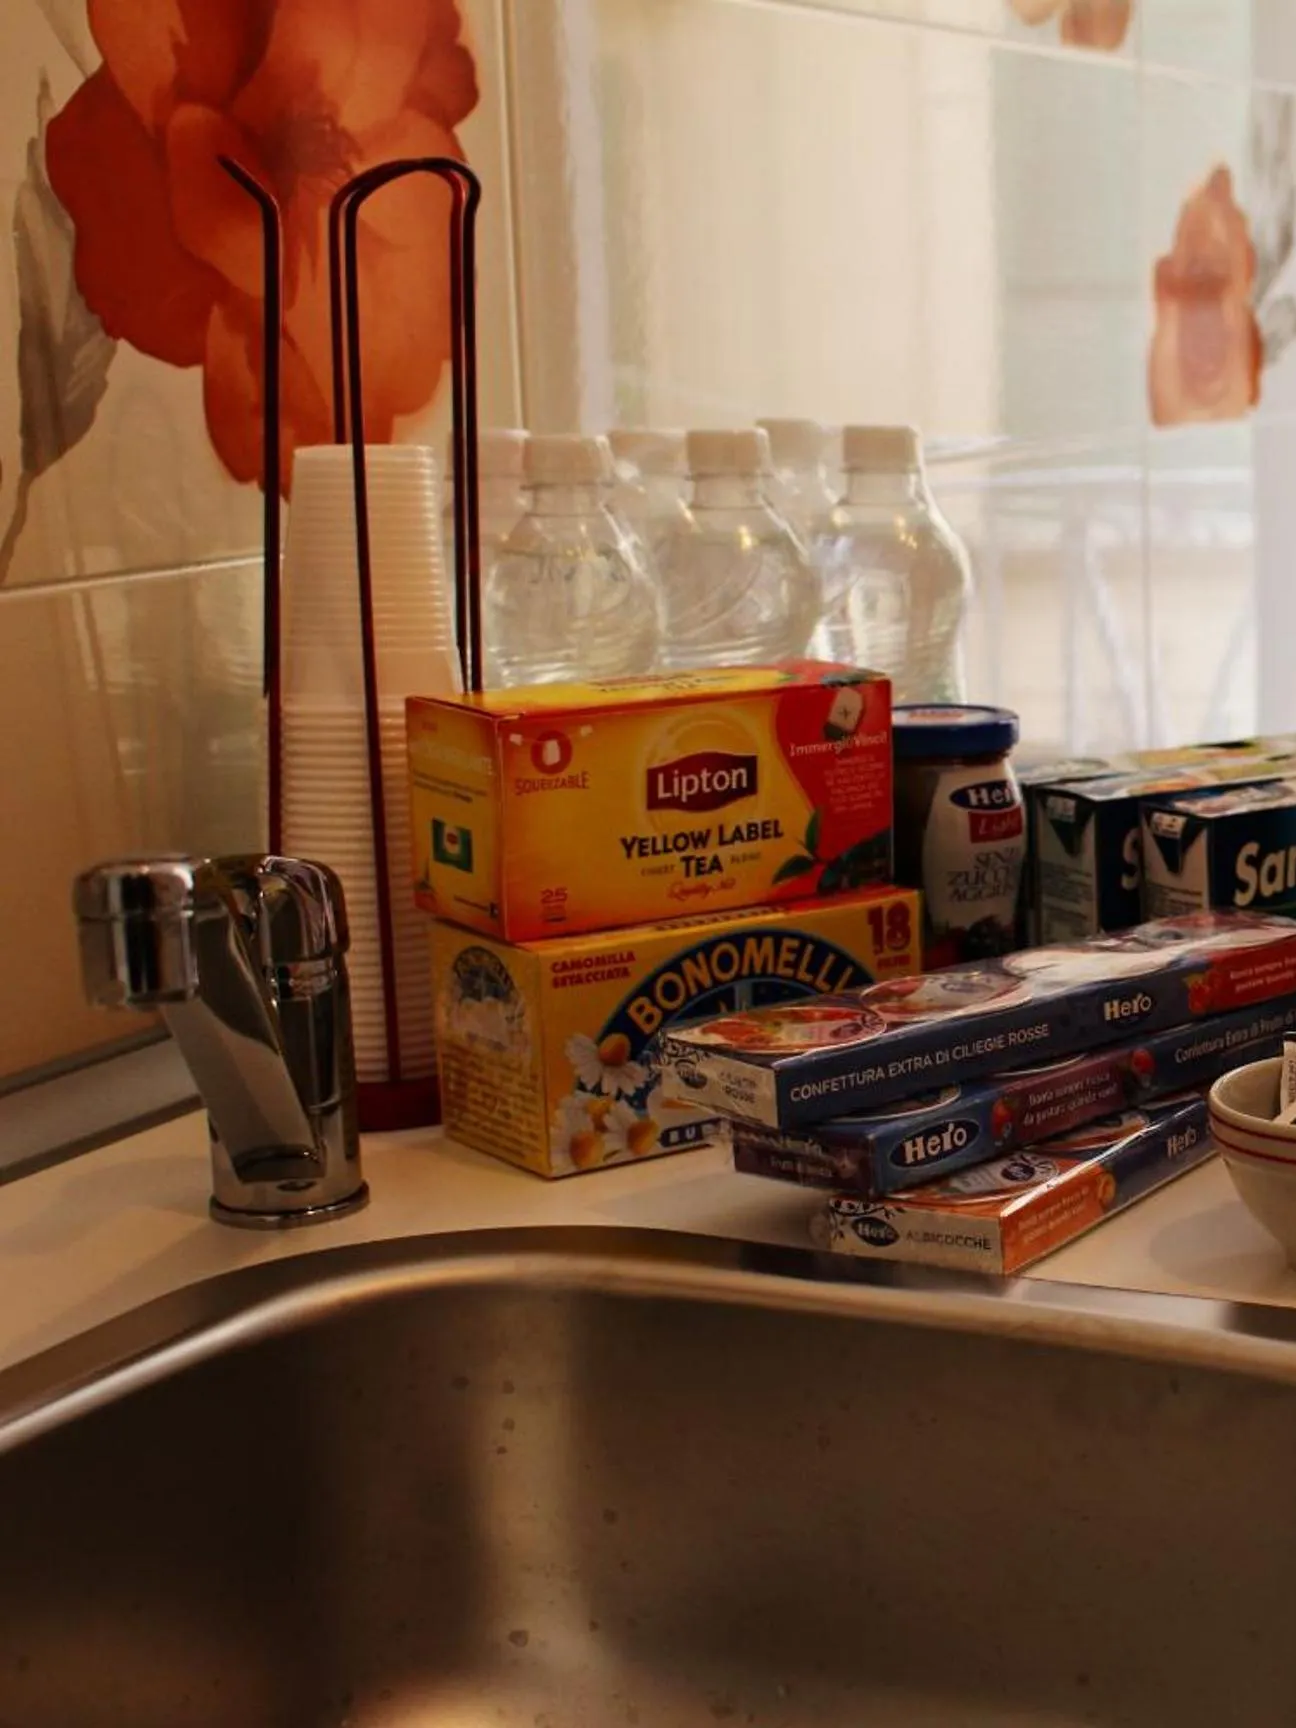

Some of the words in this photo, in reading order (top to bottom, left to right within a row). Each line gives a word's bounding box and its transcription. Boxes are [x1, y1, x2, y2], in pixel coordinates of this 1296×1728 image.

[515, 772, 590, 796] SQUEEZABLE
[656, 765, 748, 804] Lipton
[620, 828, 711, 860] YELLOW
[717, 819, 785, 846] LABEL
[680, 854, 724, 878] TEA
[540, 886, 568, 904] 25
[867, 901, 911, 955] 18
[551, 950, 637, 974] CAMOMILLA
[552, 966, 630, 989] SETACCIATA
[626, 935, 855, 1036] BONOMELLI
[1103, 991, 1153, 1022] Hero
[789, 1066, 886, 1103] CONFETTURA
[887, 1054, 935, 1078] EXTRA
[935, 1049, 950, 1065] DI
[952, 1034, 1006, 1061] CILIEGIE
[1007, 1023, 1051, 1047] ROSSE
[902, 1122, 968, 1164] Hero
[1166, 1125, 1198, 1157] Hero
[857, 1222, 895, 1243] Hero
[905, 1229, 993, 1251] ALBICOCCHE
